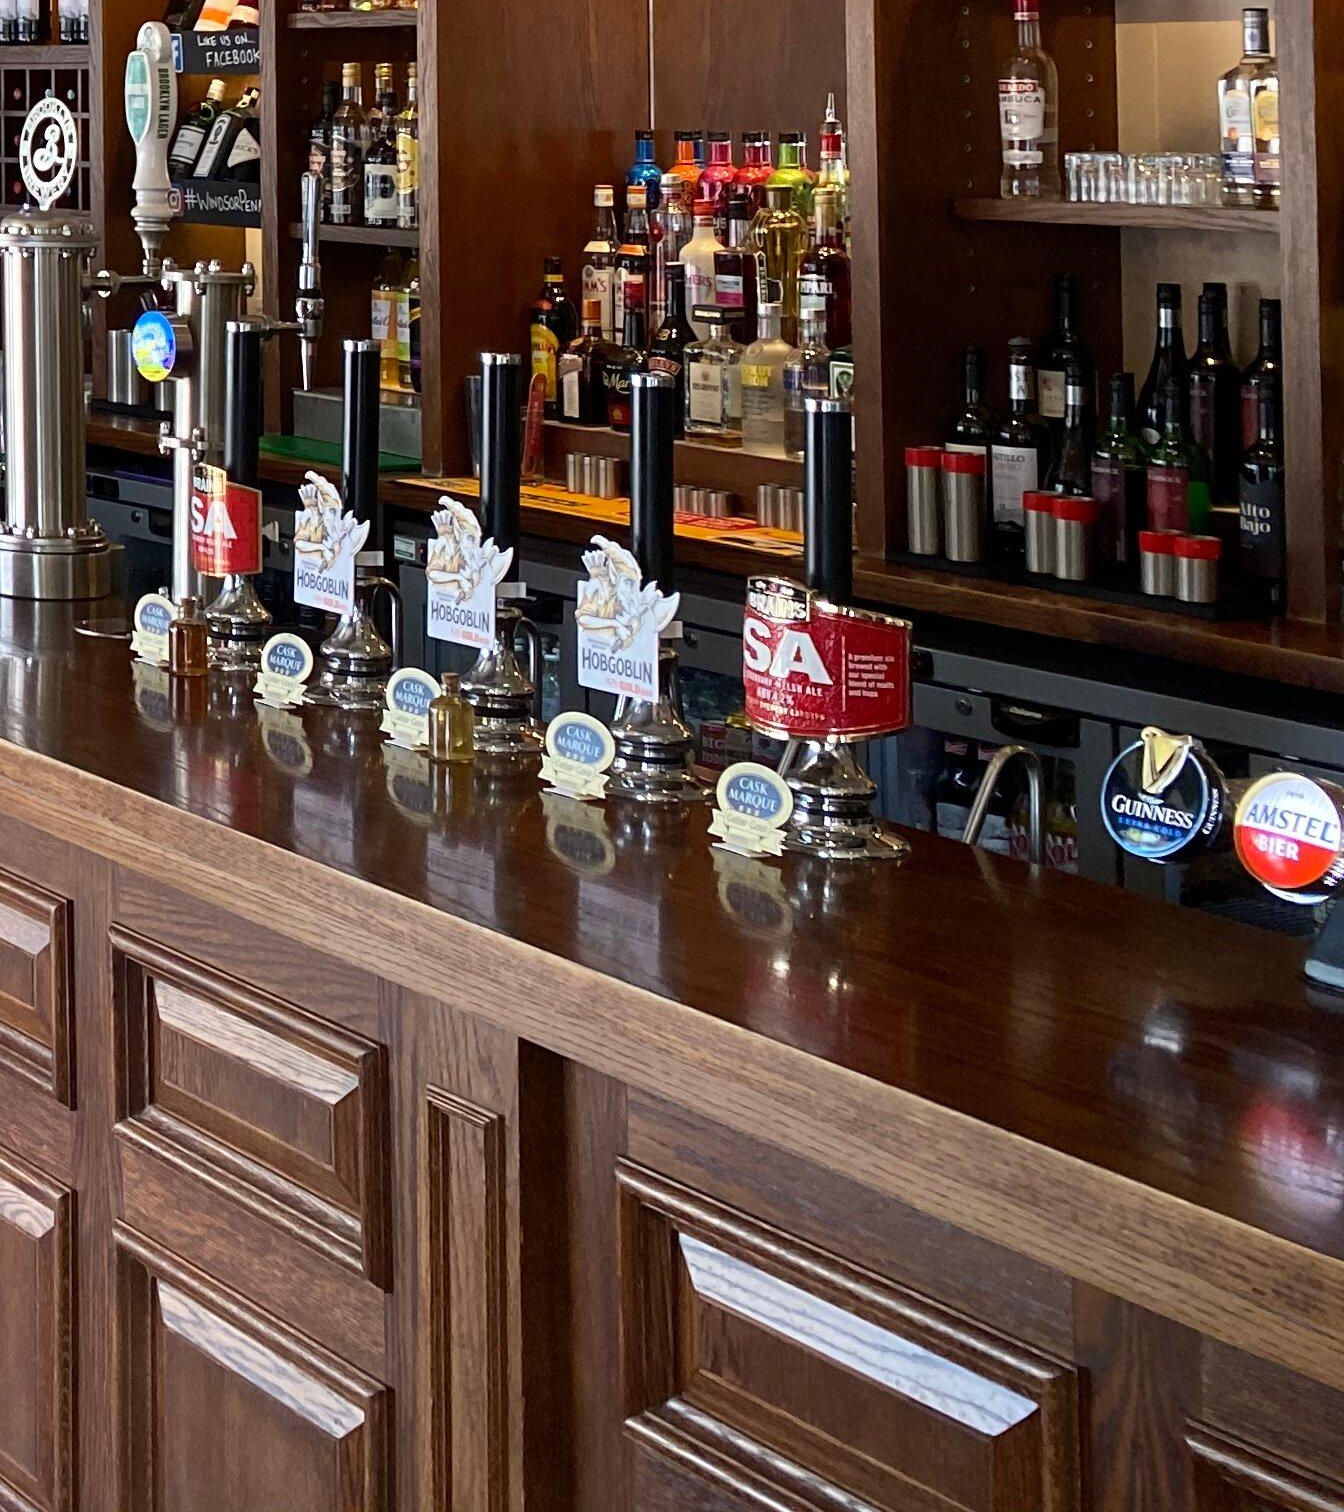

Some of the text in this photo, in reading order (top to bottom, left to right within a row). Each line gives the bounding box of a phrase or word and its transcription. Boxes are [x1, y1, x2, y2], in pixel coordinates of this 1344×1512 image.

[198, 35, 217, 46] LIKE
[220, 35, 231, 46] US
[206, 48, 261, 68] FACEBOOK
[158, 69, 170, 110] BROOKLYN
[192, 495, 237, 540] SA
[297, 568, 349, 600] HOBGOBLIN
[431, 601, 490, 634] HOBGOBLIN
[270, 655, 303, 672] MARQUE
[276, 645, 297, 658] CASK
[743, 617, 833, 686] SA
[582, 647, 653, 685] HOBGOBLIN
[402, 681, 424, 696] CASK
[806, 685, 823, 697] ALE
[566, 725, 593, 742] CASK
[556, 737, 601, 758] MARQUE
[739, 777, 768, 795] CASK
[729, 788, 777, 813] MARQUE
[1112, 794, 1194, 829] GUINNESS
[1246, 803, 1334, 843] AMSTEL
[1256, 833, 1299, 862] BIER
